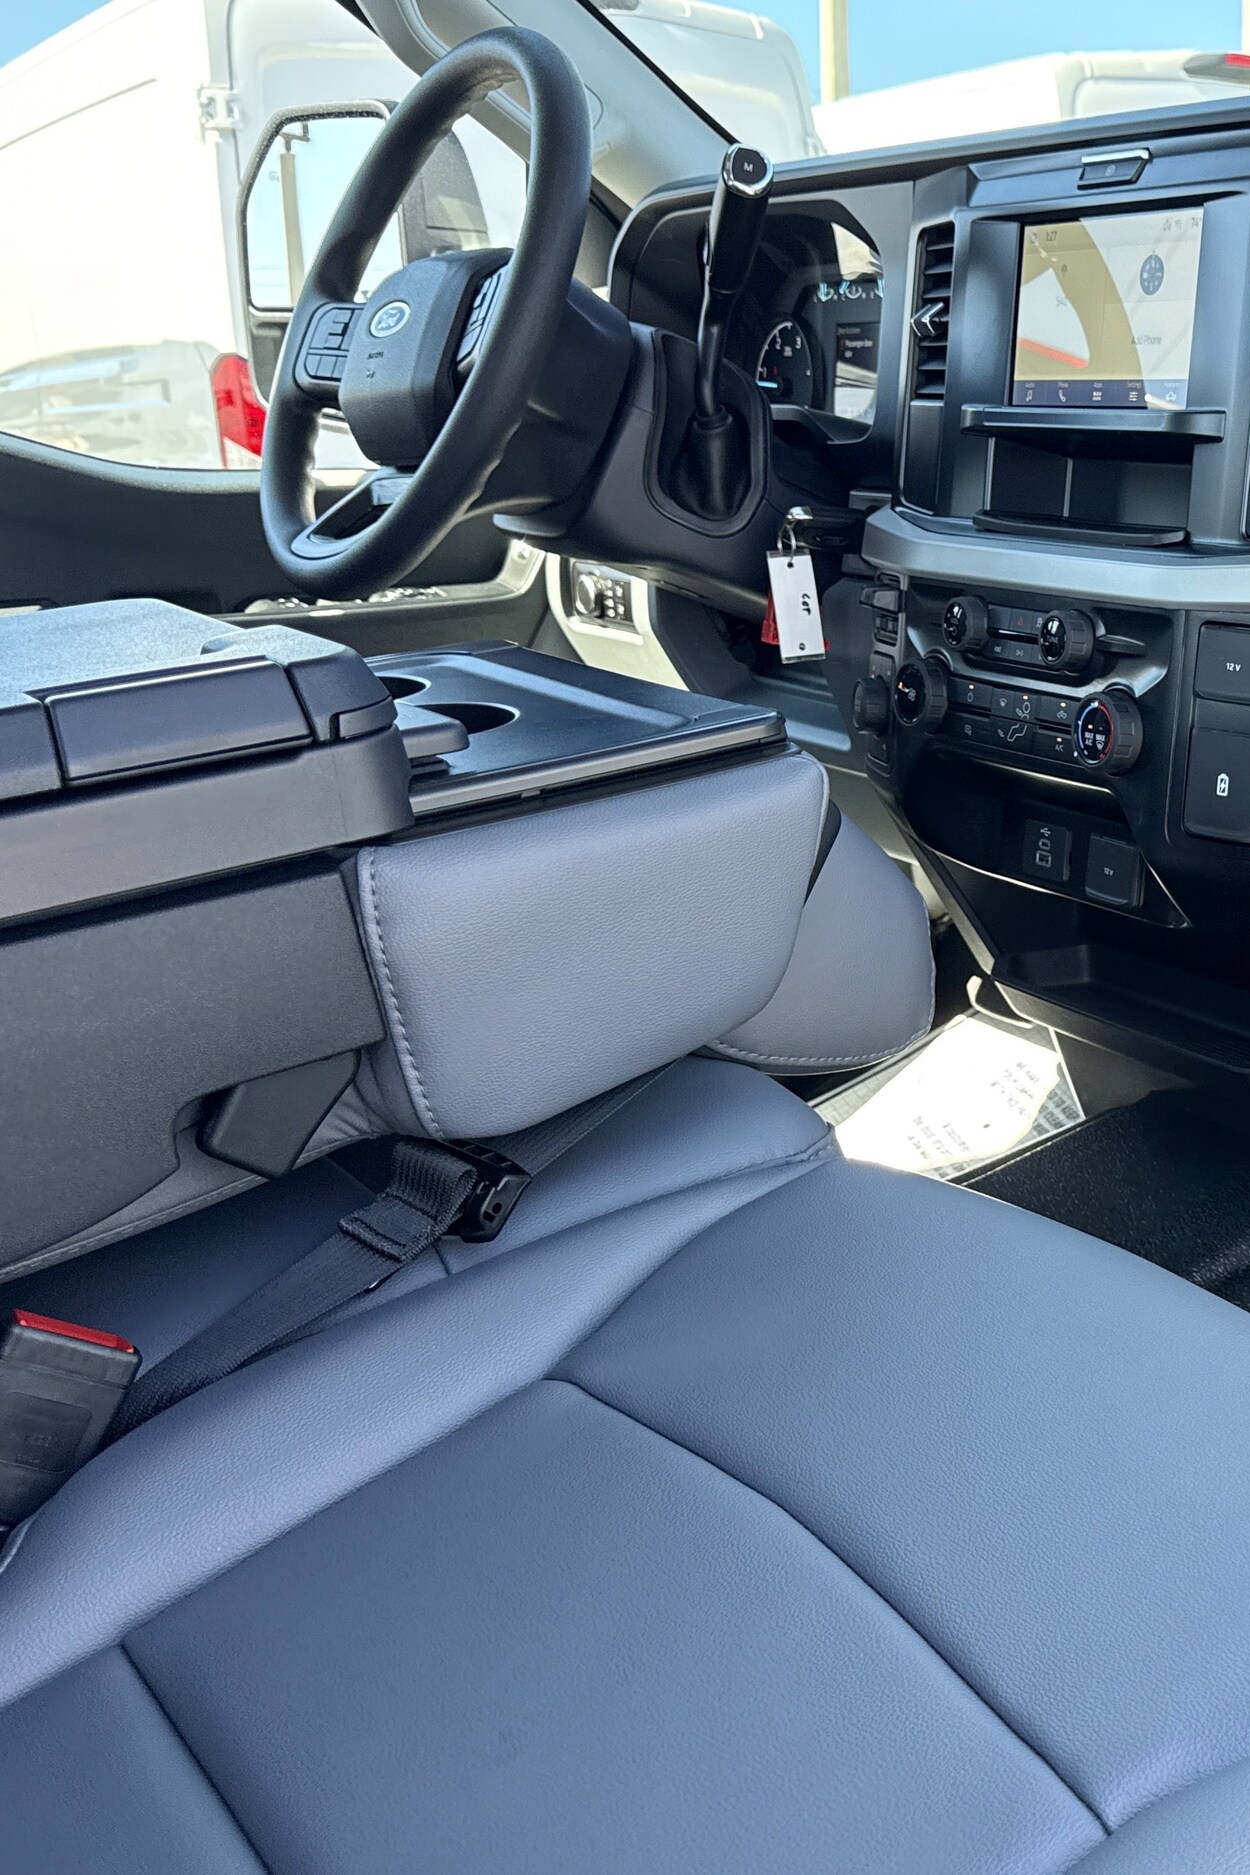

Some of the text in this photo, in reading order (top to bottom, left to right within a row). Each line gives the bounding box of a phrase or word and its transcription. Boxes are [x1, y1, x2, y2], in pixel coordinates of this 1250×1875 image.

[743, 161, 753, 172] M
[1143, 334, 1162, 346] Phone
[1055, 744, 1064, 752] A/C
